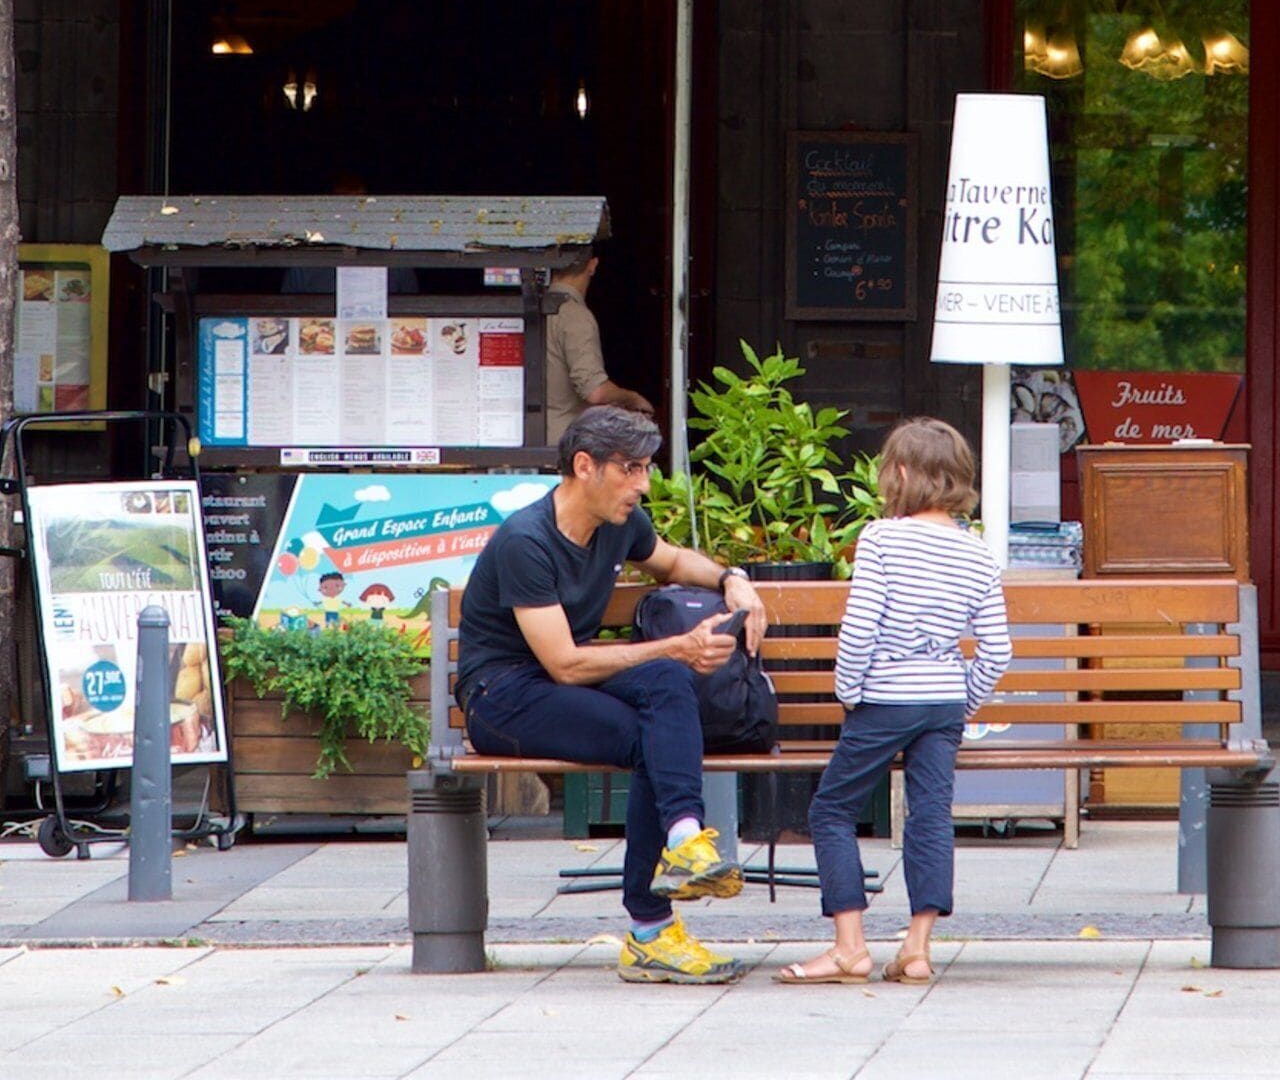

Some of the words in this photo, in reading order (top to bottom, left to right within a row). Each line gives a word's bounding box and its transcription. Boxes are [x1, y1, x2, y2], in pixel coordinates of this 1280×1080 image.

[960, 178, 1047, 204] Taverne
[984, 294, 1041, 313] VENTE
[1111, 381, 1186, 408] Fruits
[1114, 417, 1143, 440] de
[1151, 424, 1197, 441] mer
[333, 522, 379, 546] Grand
[382, 519, 427, 537] Espace
[432, 506, 488, 528] Enfants
[343, 552, 353, 568] à
[358, 543, 431, 567] disposition
[437, 538, 446, 554] à
